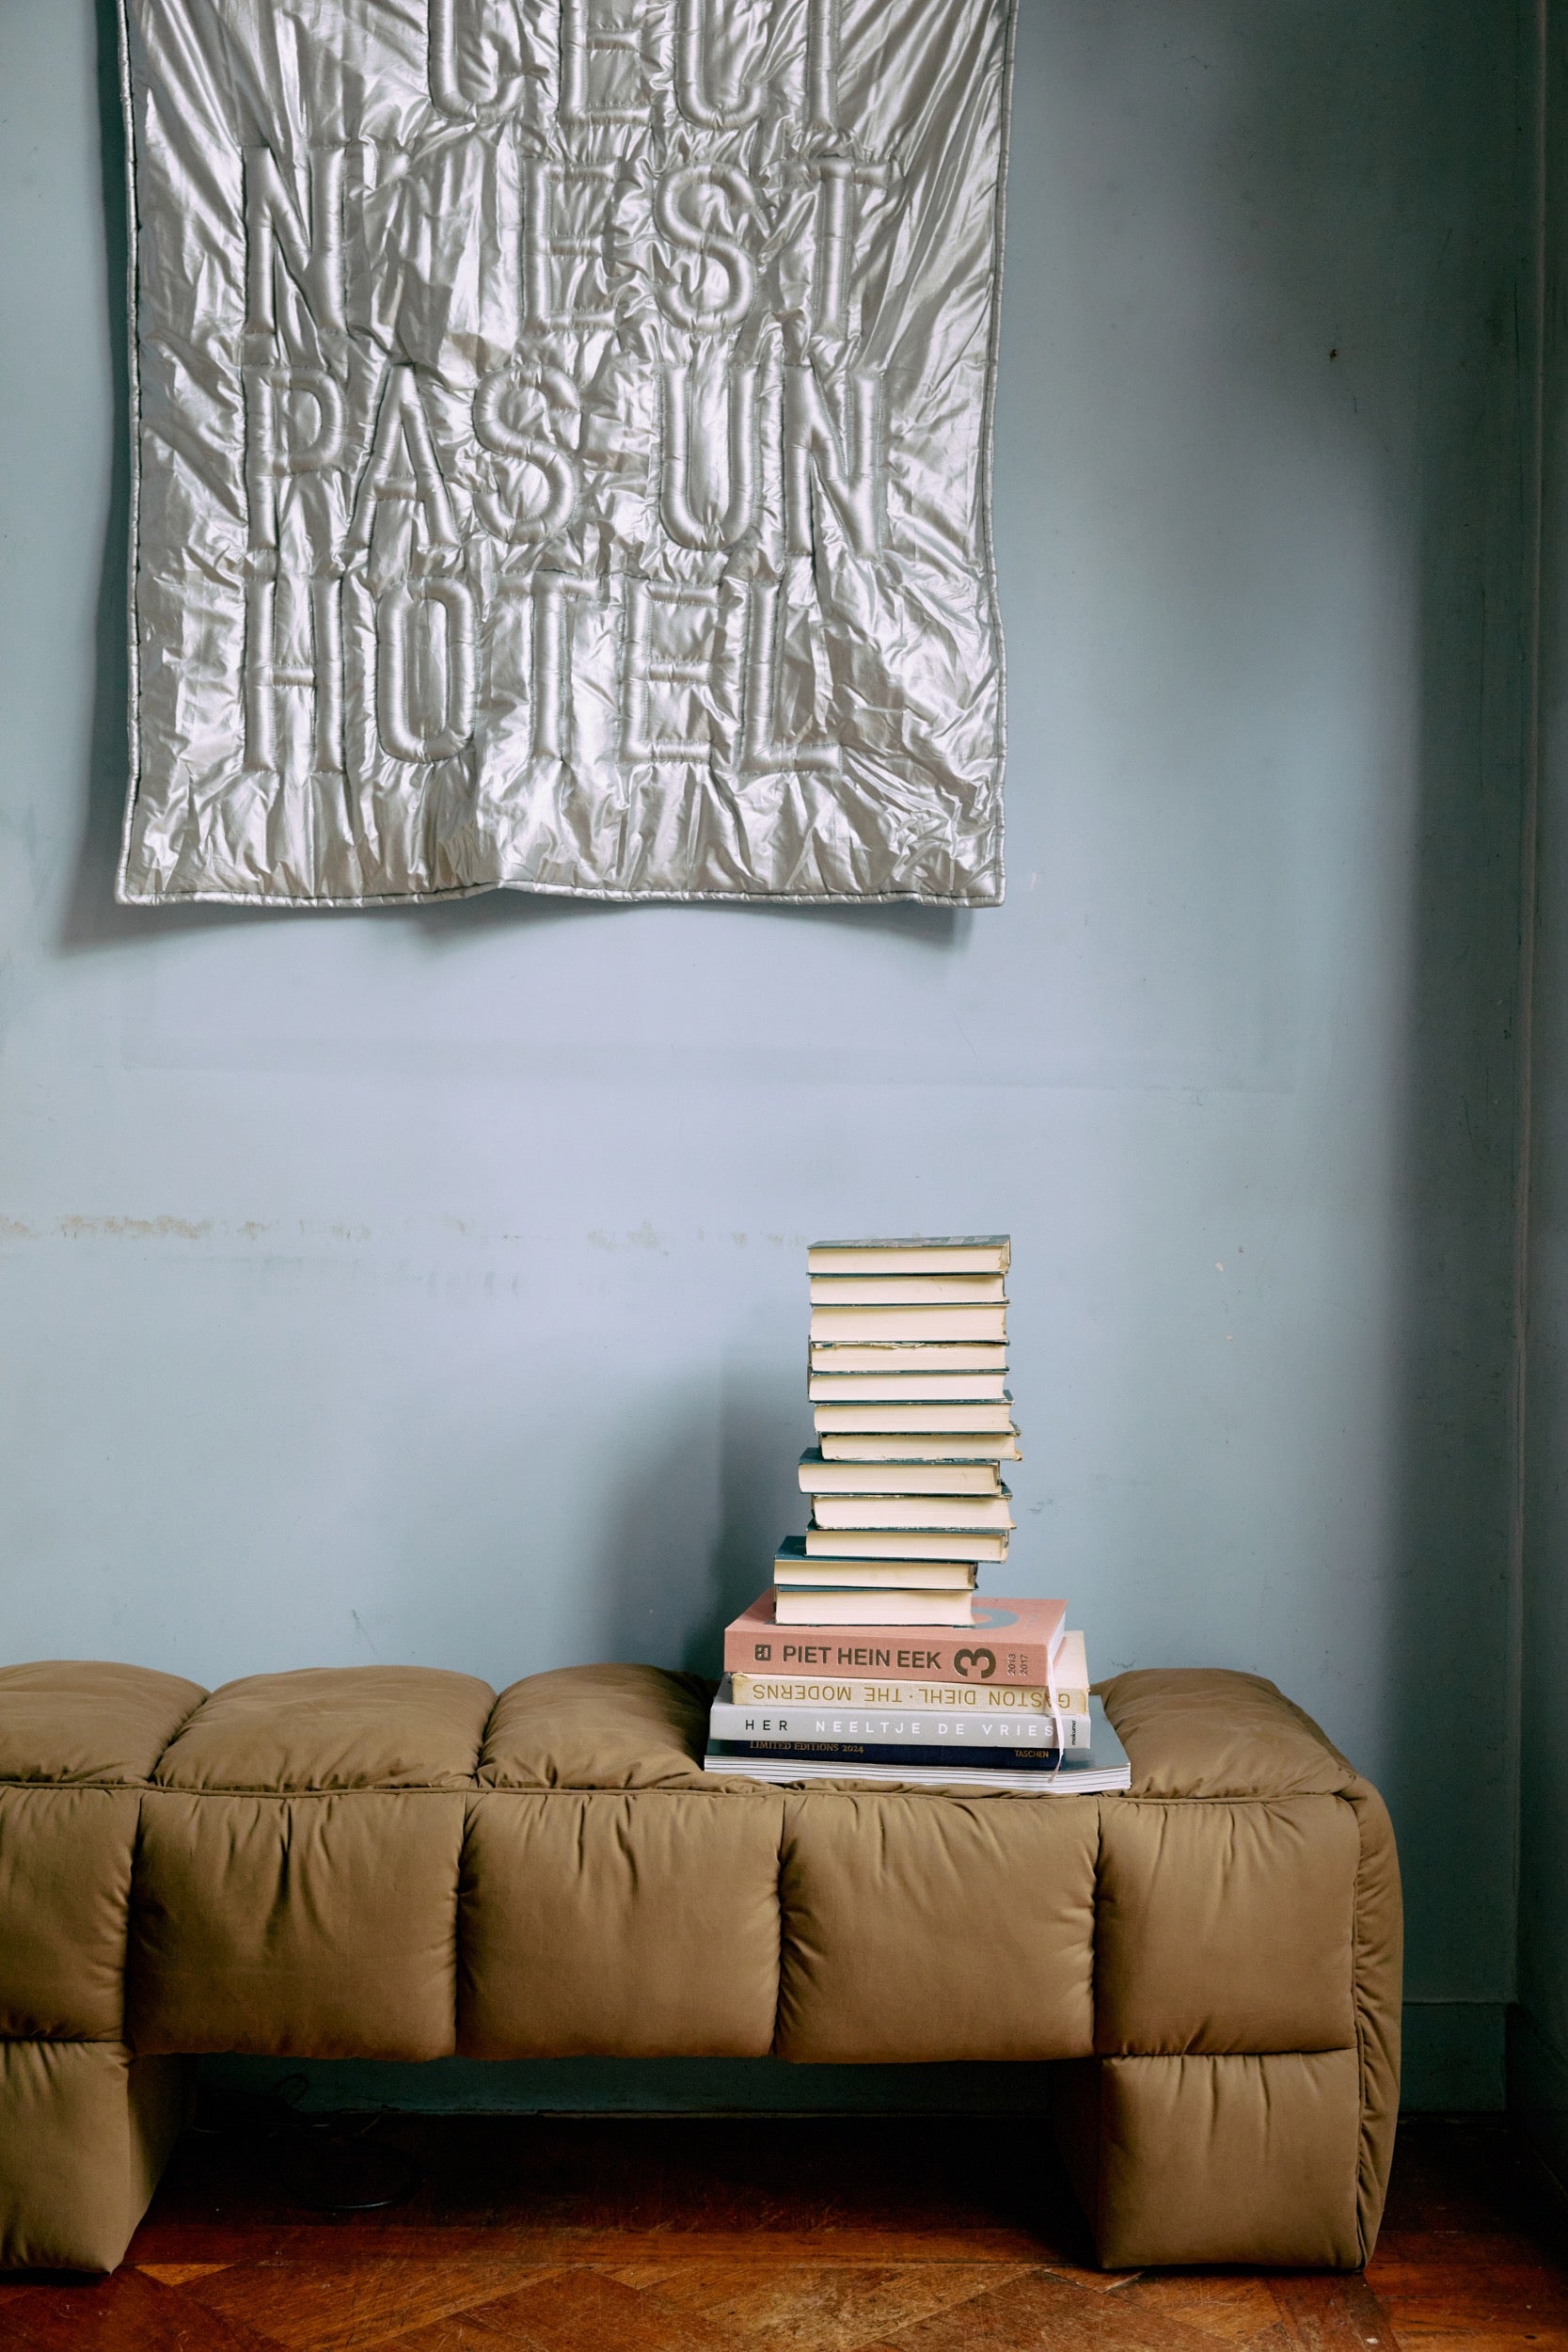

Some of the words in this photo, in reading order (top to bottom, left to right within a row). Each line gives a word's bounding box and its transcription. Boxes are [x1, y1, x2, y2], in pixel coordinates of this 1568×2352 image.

[428, 0, 839, 130] CECI
[244, 362, 588, 551] PAS
[658, 359, 890, 563] UN
[244, 571, 844, 772] HOTEL
[782, 1645, 832, 1664] PIET
[837, 1647, 890, 1667] HEIN
[897, 1650, 942, 1670] EEK
[953, 1647, 997, 1679] 3
[1007, 1653, 1017, 1677] 2013
[1020, 1654, 1028, 1677] 2017
[752, 1684, 851, 1701] MODERNS
[863, 1686, 903, 1703] THE
[918, 1688, 976, 1706] DIEHL
[745, 1720, 788, 1731] HER
[816, 1721, 921, 1734] NEELTJE
[938, 1724, 965, 1735] DE
[982, 1724, 1054, 1737] VRIES
[749, 1740, 792, 1750] LIMITED
[794, 1741, 839, 1753] EDITIONS
[842, 1744, 864, 1755] 2024
[1014, 1749, 1050, 1758] TASCHEN
